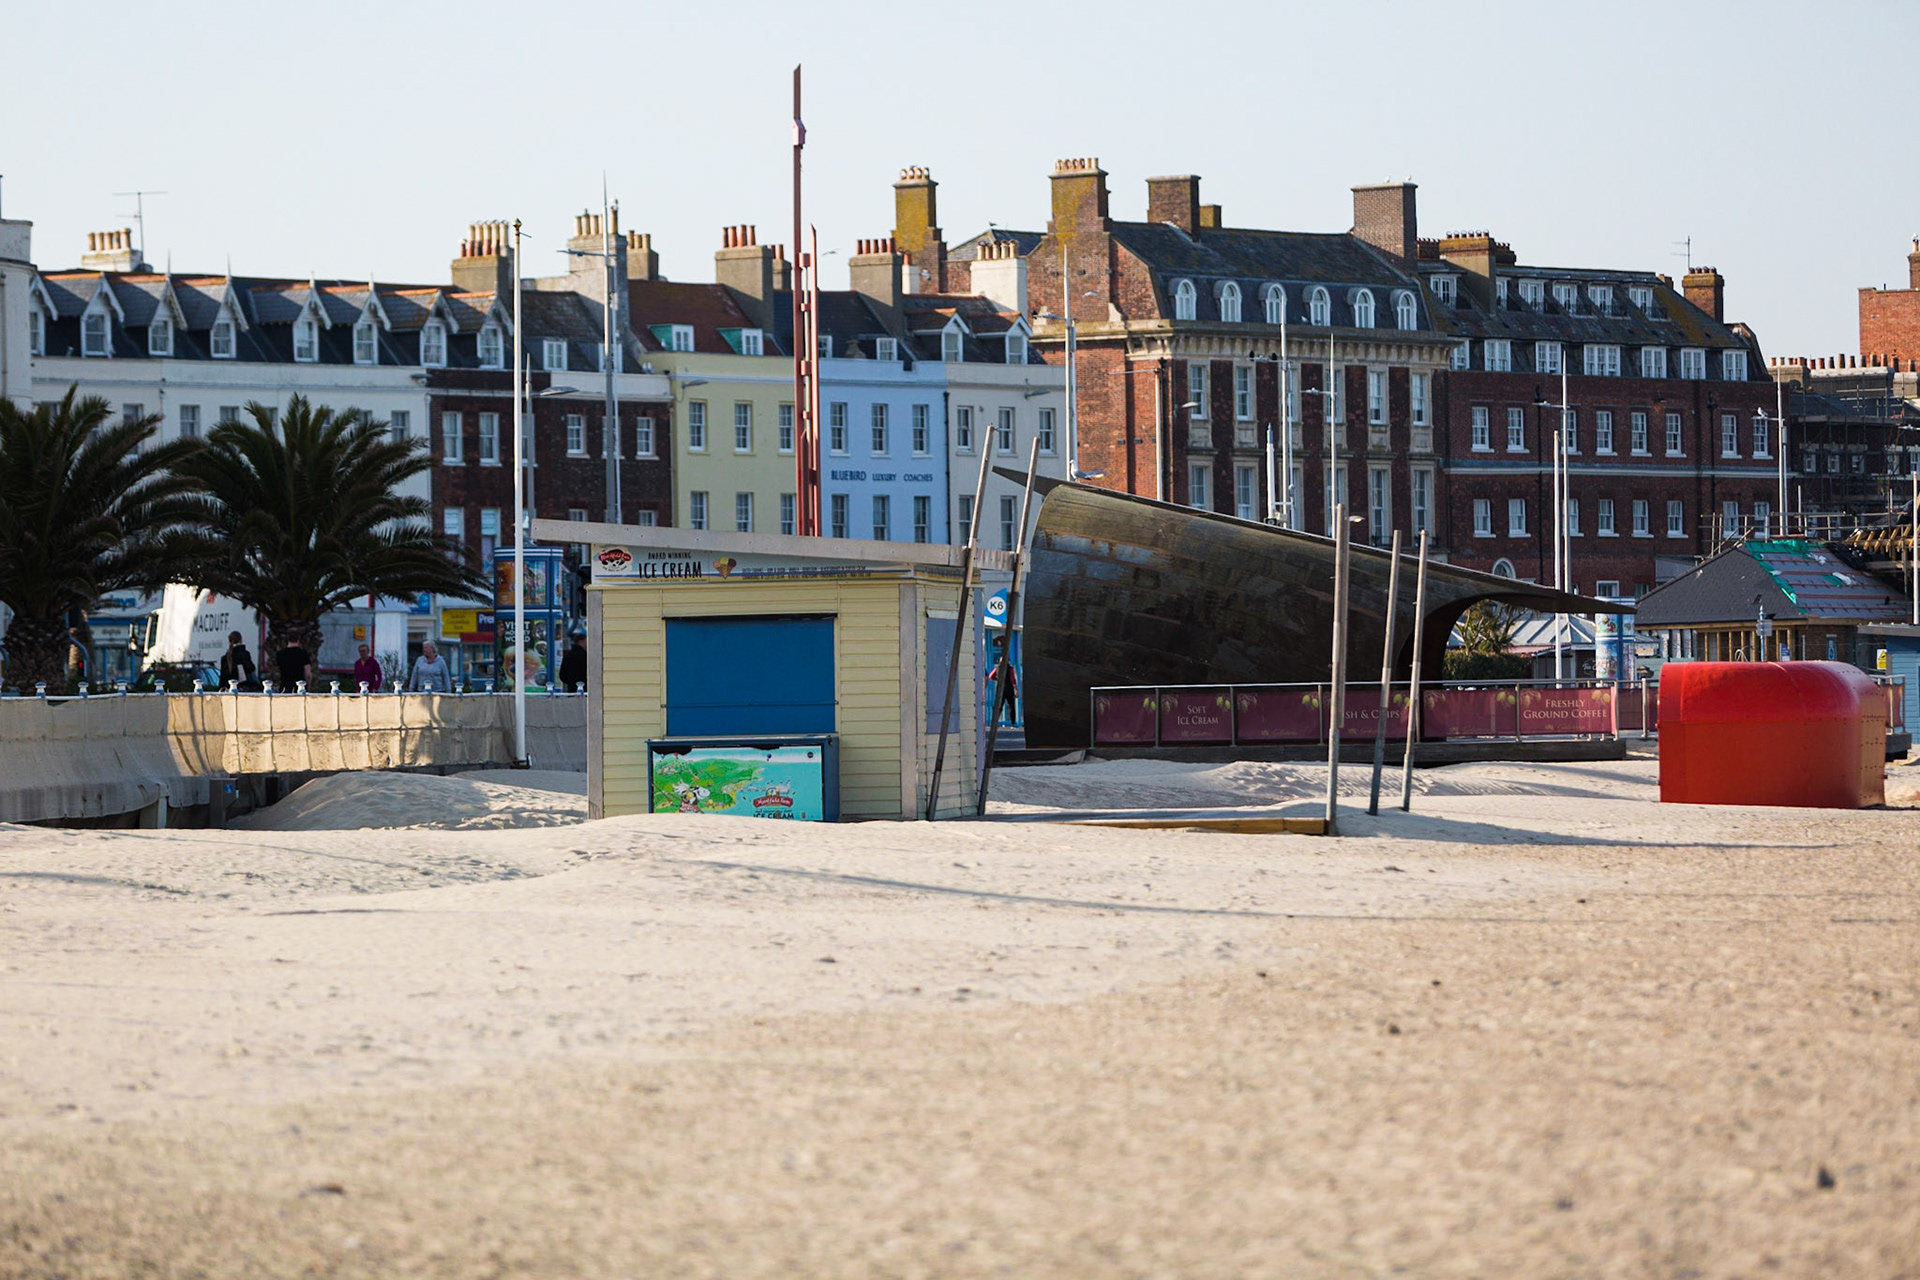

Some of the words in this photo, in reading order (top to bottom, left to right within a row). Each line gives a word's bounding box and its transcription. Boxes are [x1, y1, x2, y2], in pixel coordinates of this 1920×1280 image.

[831, 470, 866, 481] BLUEBIRD
[872, 473, 896, 482] LUXURY
[903, 473, 933, 482] COACHES
[668, 552, 691, 560] WINNING
[638, 563, 657, 579] ICE
[662, 561, 702, 579] CREAM
[990, 601, 1003, 610] K6
[193, 613, 229, 632] MACDUFF
[505, 621, 530, 631] VIT
[1545, 698, 1586, 708] FRESHLY
[1187, 705, 1206, 714] SOFT
[1360, 711, 1369, 719] &
[1371, 709, 1400, 719] CIPS
[1523, 709, 1569, 719] GROUND
[1571, 709, 1607, 718] COFFEE
[1177, 716, 1189, 725] ICE
[1191, 715, 1218, 725] CREAM
